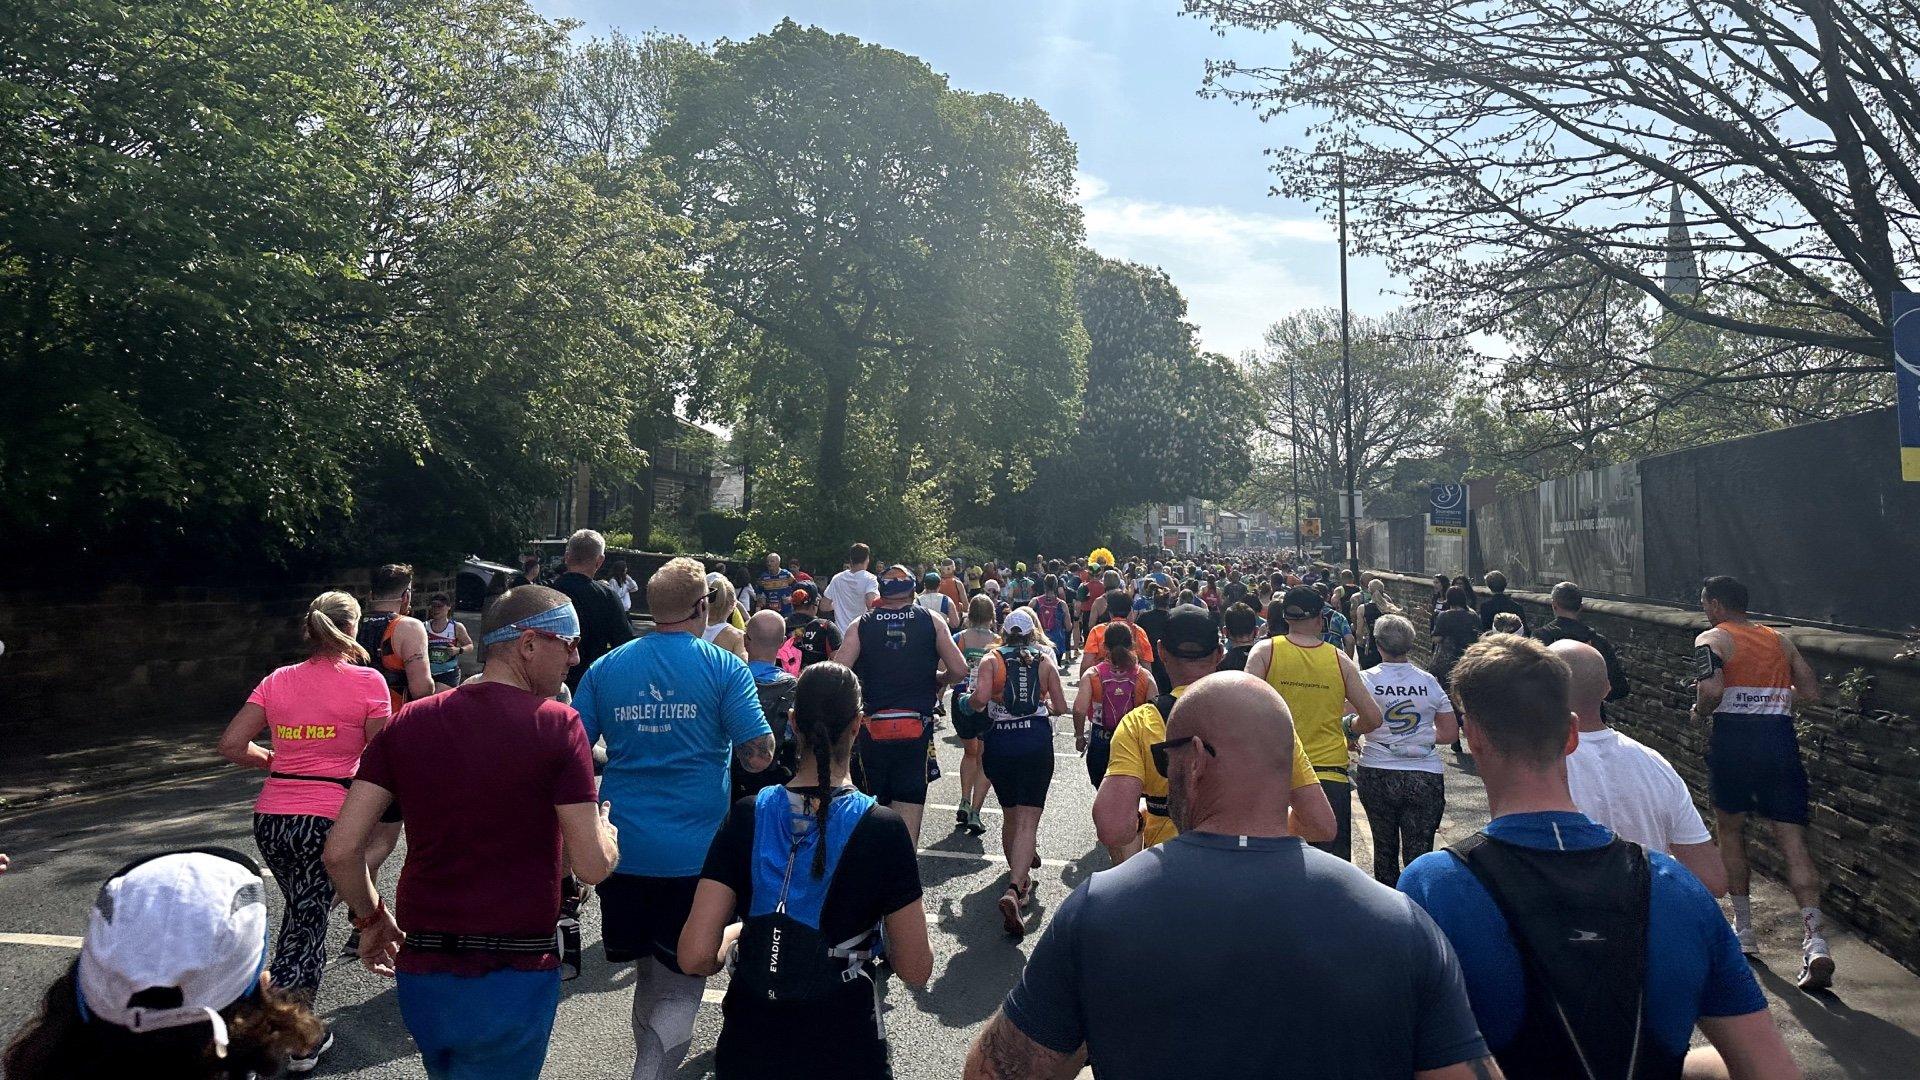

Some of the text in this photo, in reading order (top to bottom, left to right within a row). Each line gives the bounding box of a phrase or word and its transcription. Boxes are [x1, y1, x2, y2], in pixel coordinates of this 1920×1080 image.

[876, 611, 915, 621] DODDIE
[1374, 685, 1428, 696] SARAH
[614, 703, 697, 721] FARSLEY FLYERS
[276, 724, 336, 740] Mad Maz
[770, 927, 781, 973] EVADICT
